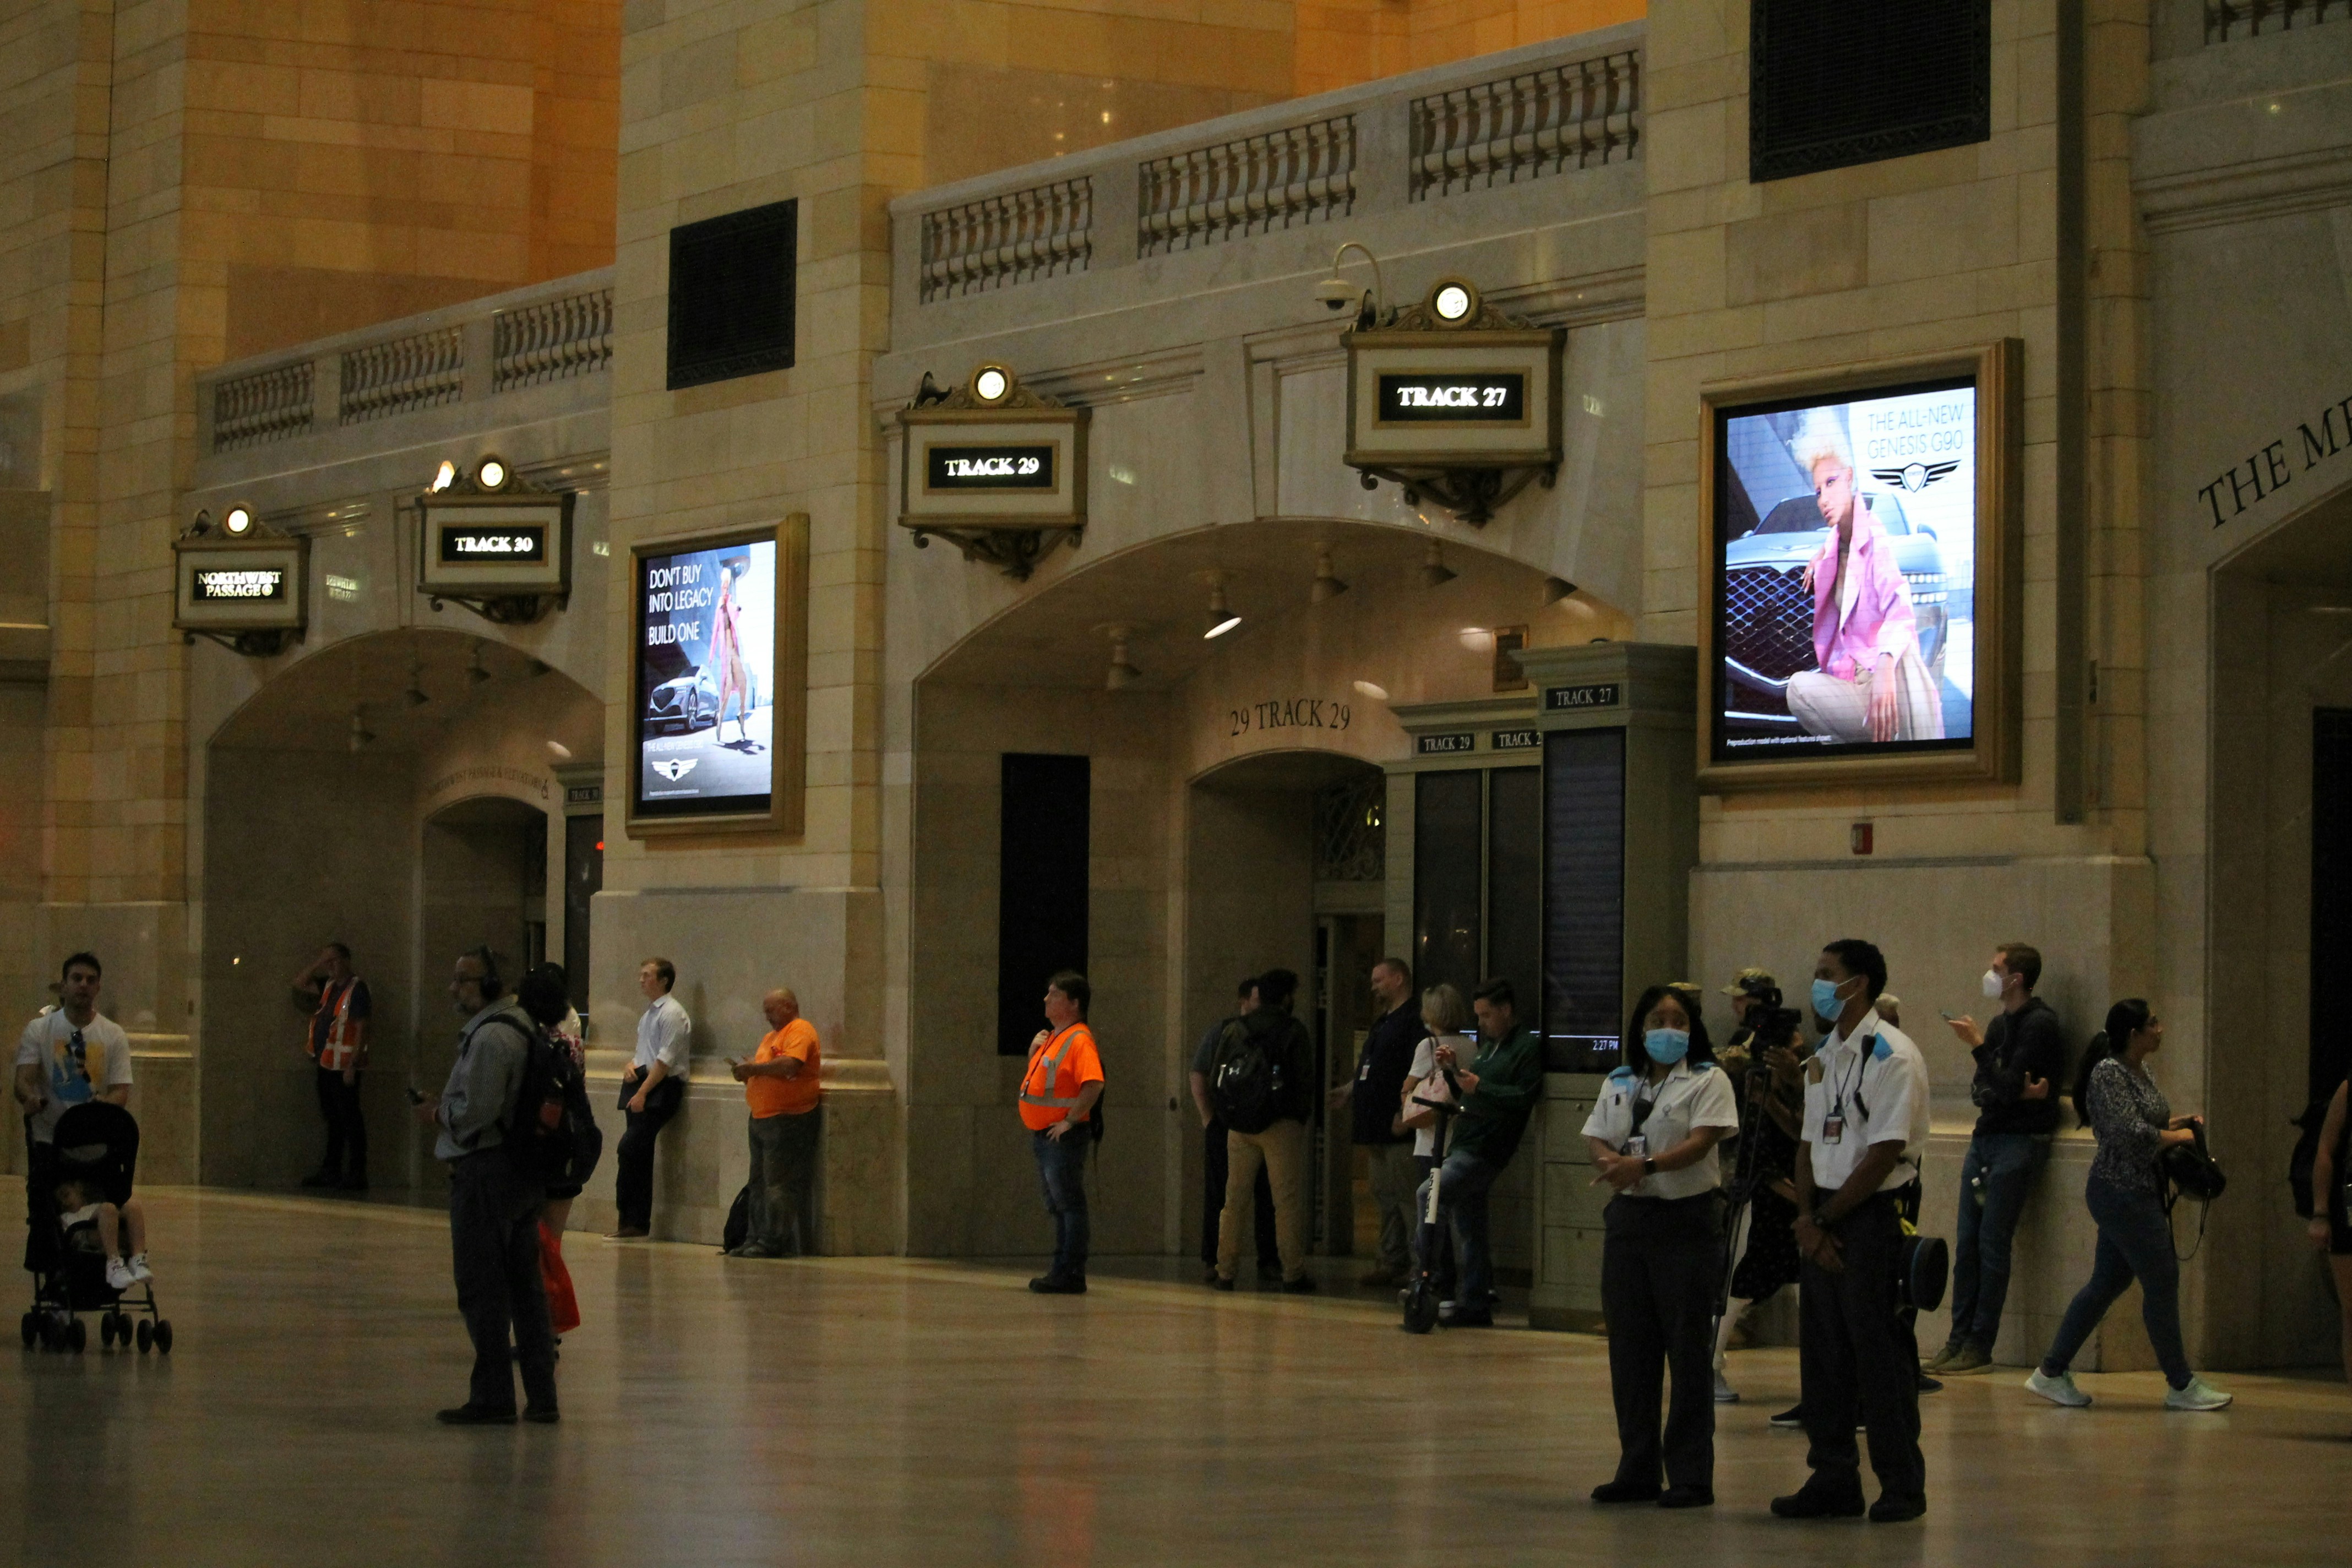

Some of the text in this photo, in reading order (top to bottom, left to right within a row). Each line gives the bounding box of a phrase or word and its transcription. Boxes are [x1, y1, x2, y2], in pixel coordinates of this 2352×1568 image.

[1397, 387, 1507, 406] TRACK 27
[1868, 404, 1963, 432] THE ALL-NEW
[1868, 430, 1963, 459] GENESIS G90
[945, 457, 1039, 476] TRACK 29
[2198, 439, 2290, 529] THE
[455, 537, 533, 552] TRACK 30
[198, 571, 281, 584] NORTHWEST
[650, 564, 702, 589] DON'T BUY
[206, 584, 261, 596] PASSAGE
[649, 587, 714, 613] INTO LEGACY
[649, 621, 700, 645] BUILD ONE
[1556, 688, 1611, 705] TRACK 27
[1231, 698, 1351, 737] 29 TRACK 29
[1425, 736, 1470, 751] TRACK 29
[1499, 732, 1542, 747] TRACK 2
[1593, 1040, 1618, 1050] 2:27 PM
